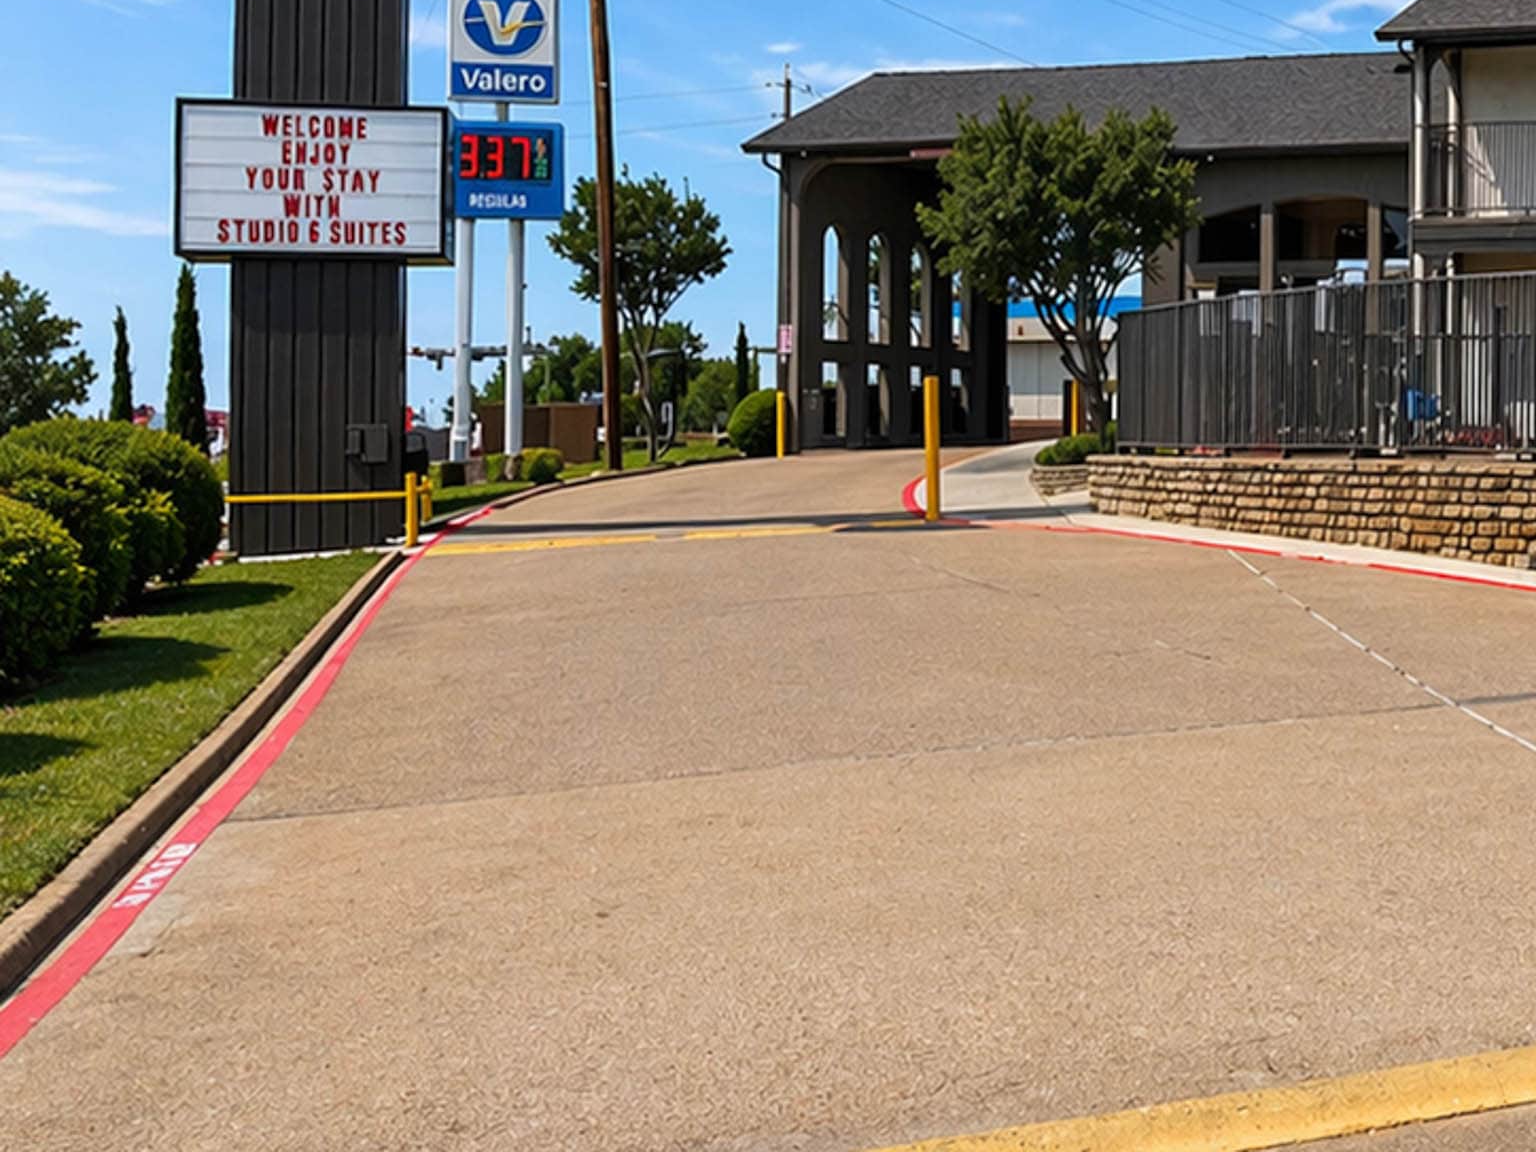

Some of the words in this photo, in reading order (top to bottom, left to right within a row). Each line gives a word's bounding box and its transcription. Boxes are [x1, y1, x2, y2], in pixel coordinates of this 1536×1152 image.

[460, 66, 546, 93] Valero
[261, 113, 368, 140] WELCOME
[281, 140, 351, 165] ENJOY
[245, 166, 305, 190] YOUR
[322, 167, 381, 193] STAY
[283, 194, 341, 219] WITH
[217, 218, 300, 244] STUDIO
[308, 220, 320, 244] 6
[329, 220, 407, 246] SUITES
